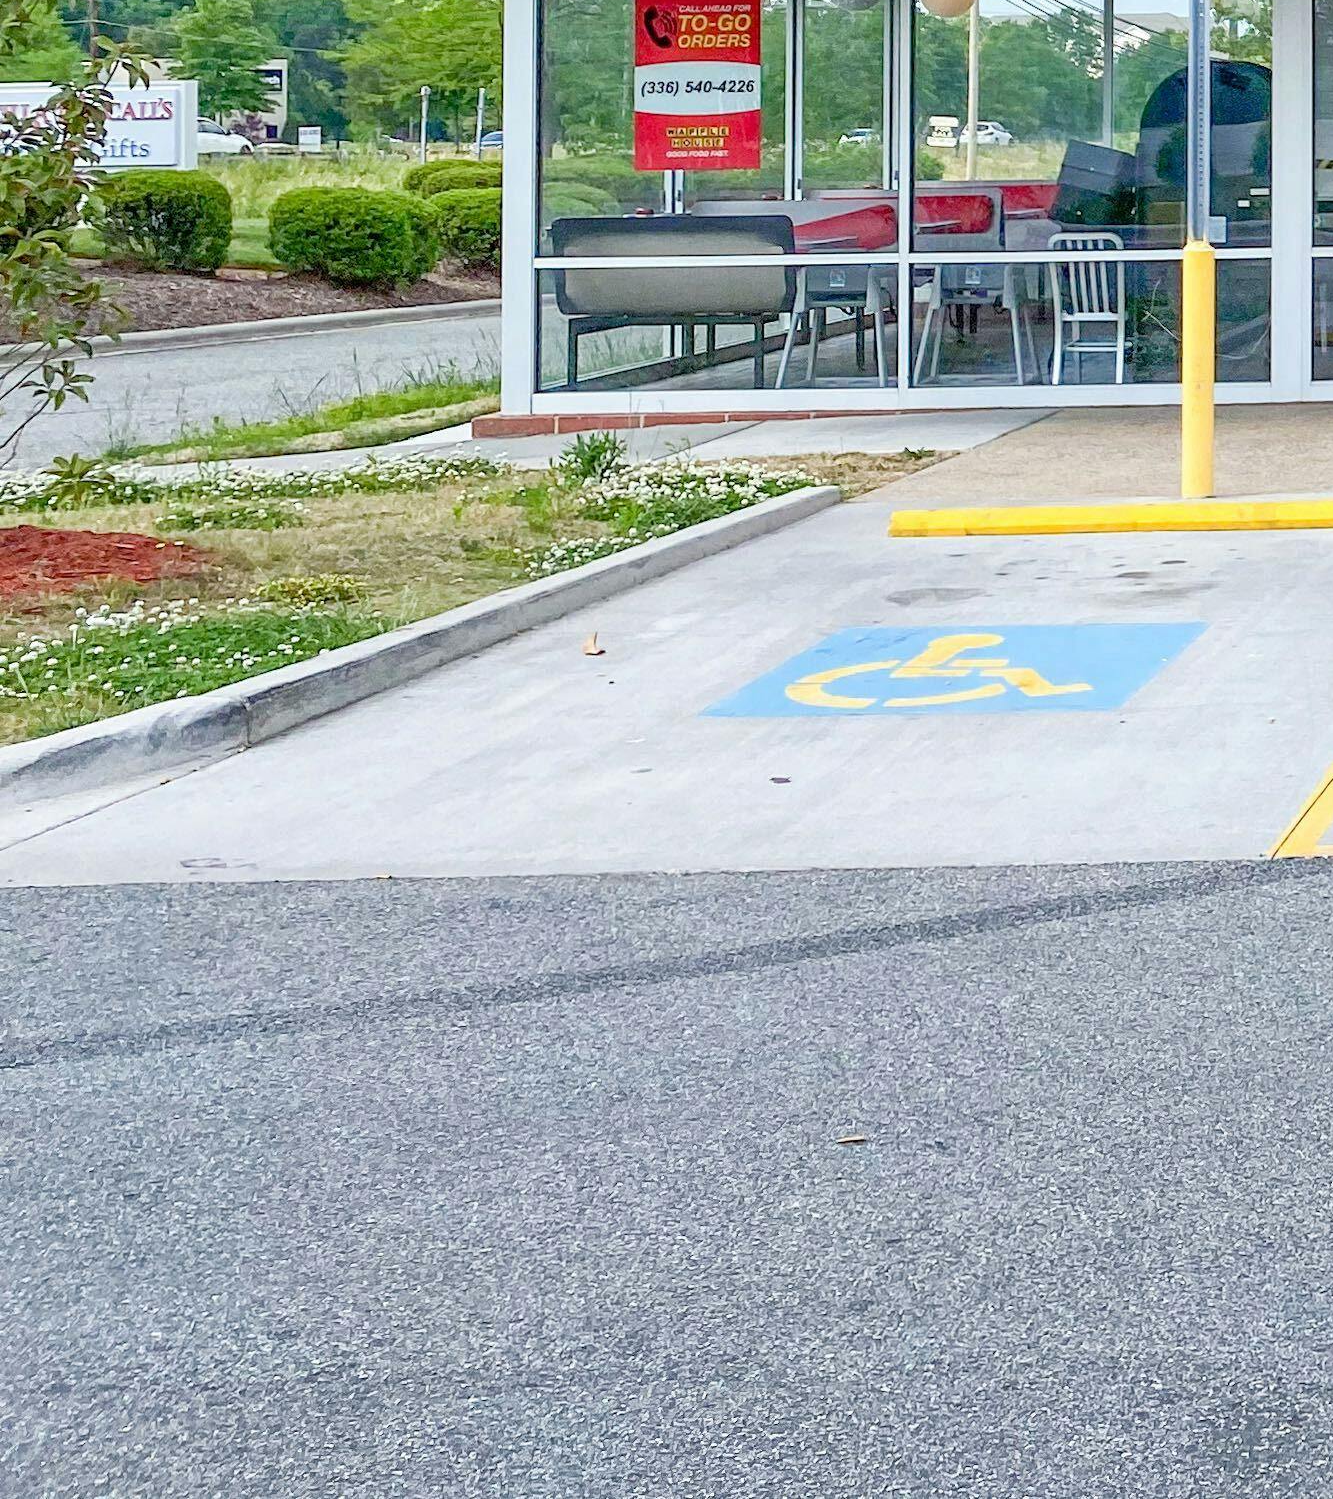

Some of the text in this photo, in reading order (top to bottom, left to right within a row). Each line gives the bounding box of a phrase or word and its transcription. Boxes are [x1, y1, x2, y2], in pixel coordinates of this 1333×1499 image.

[703, 4, 732, 12] AHEAD
[733, 4, 752, 12] FOR
[678, 13, 752, 32] TO-GO
[677, 34, 752, 48] ORDERS
[641, 80, 755, 97] (336) 540-4226
[667, 127, 728, 137] WAFFLE
[672, 137, 724, 147] HOUSE
